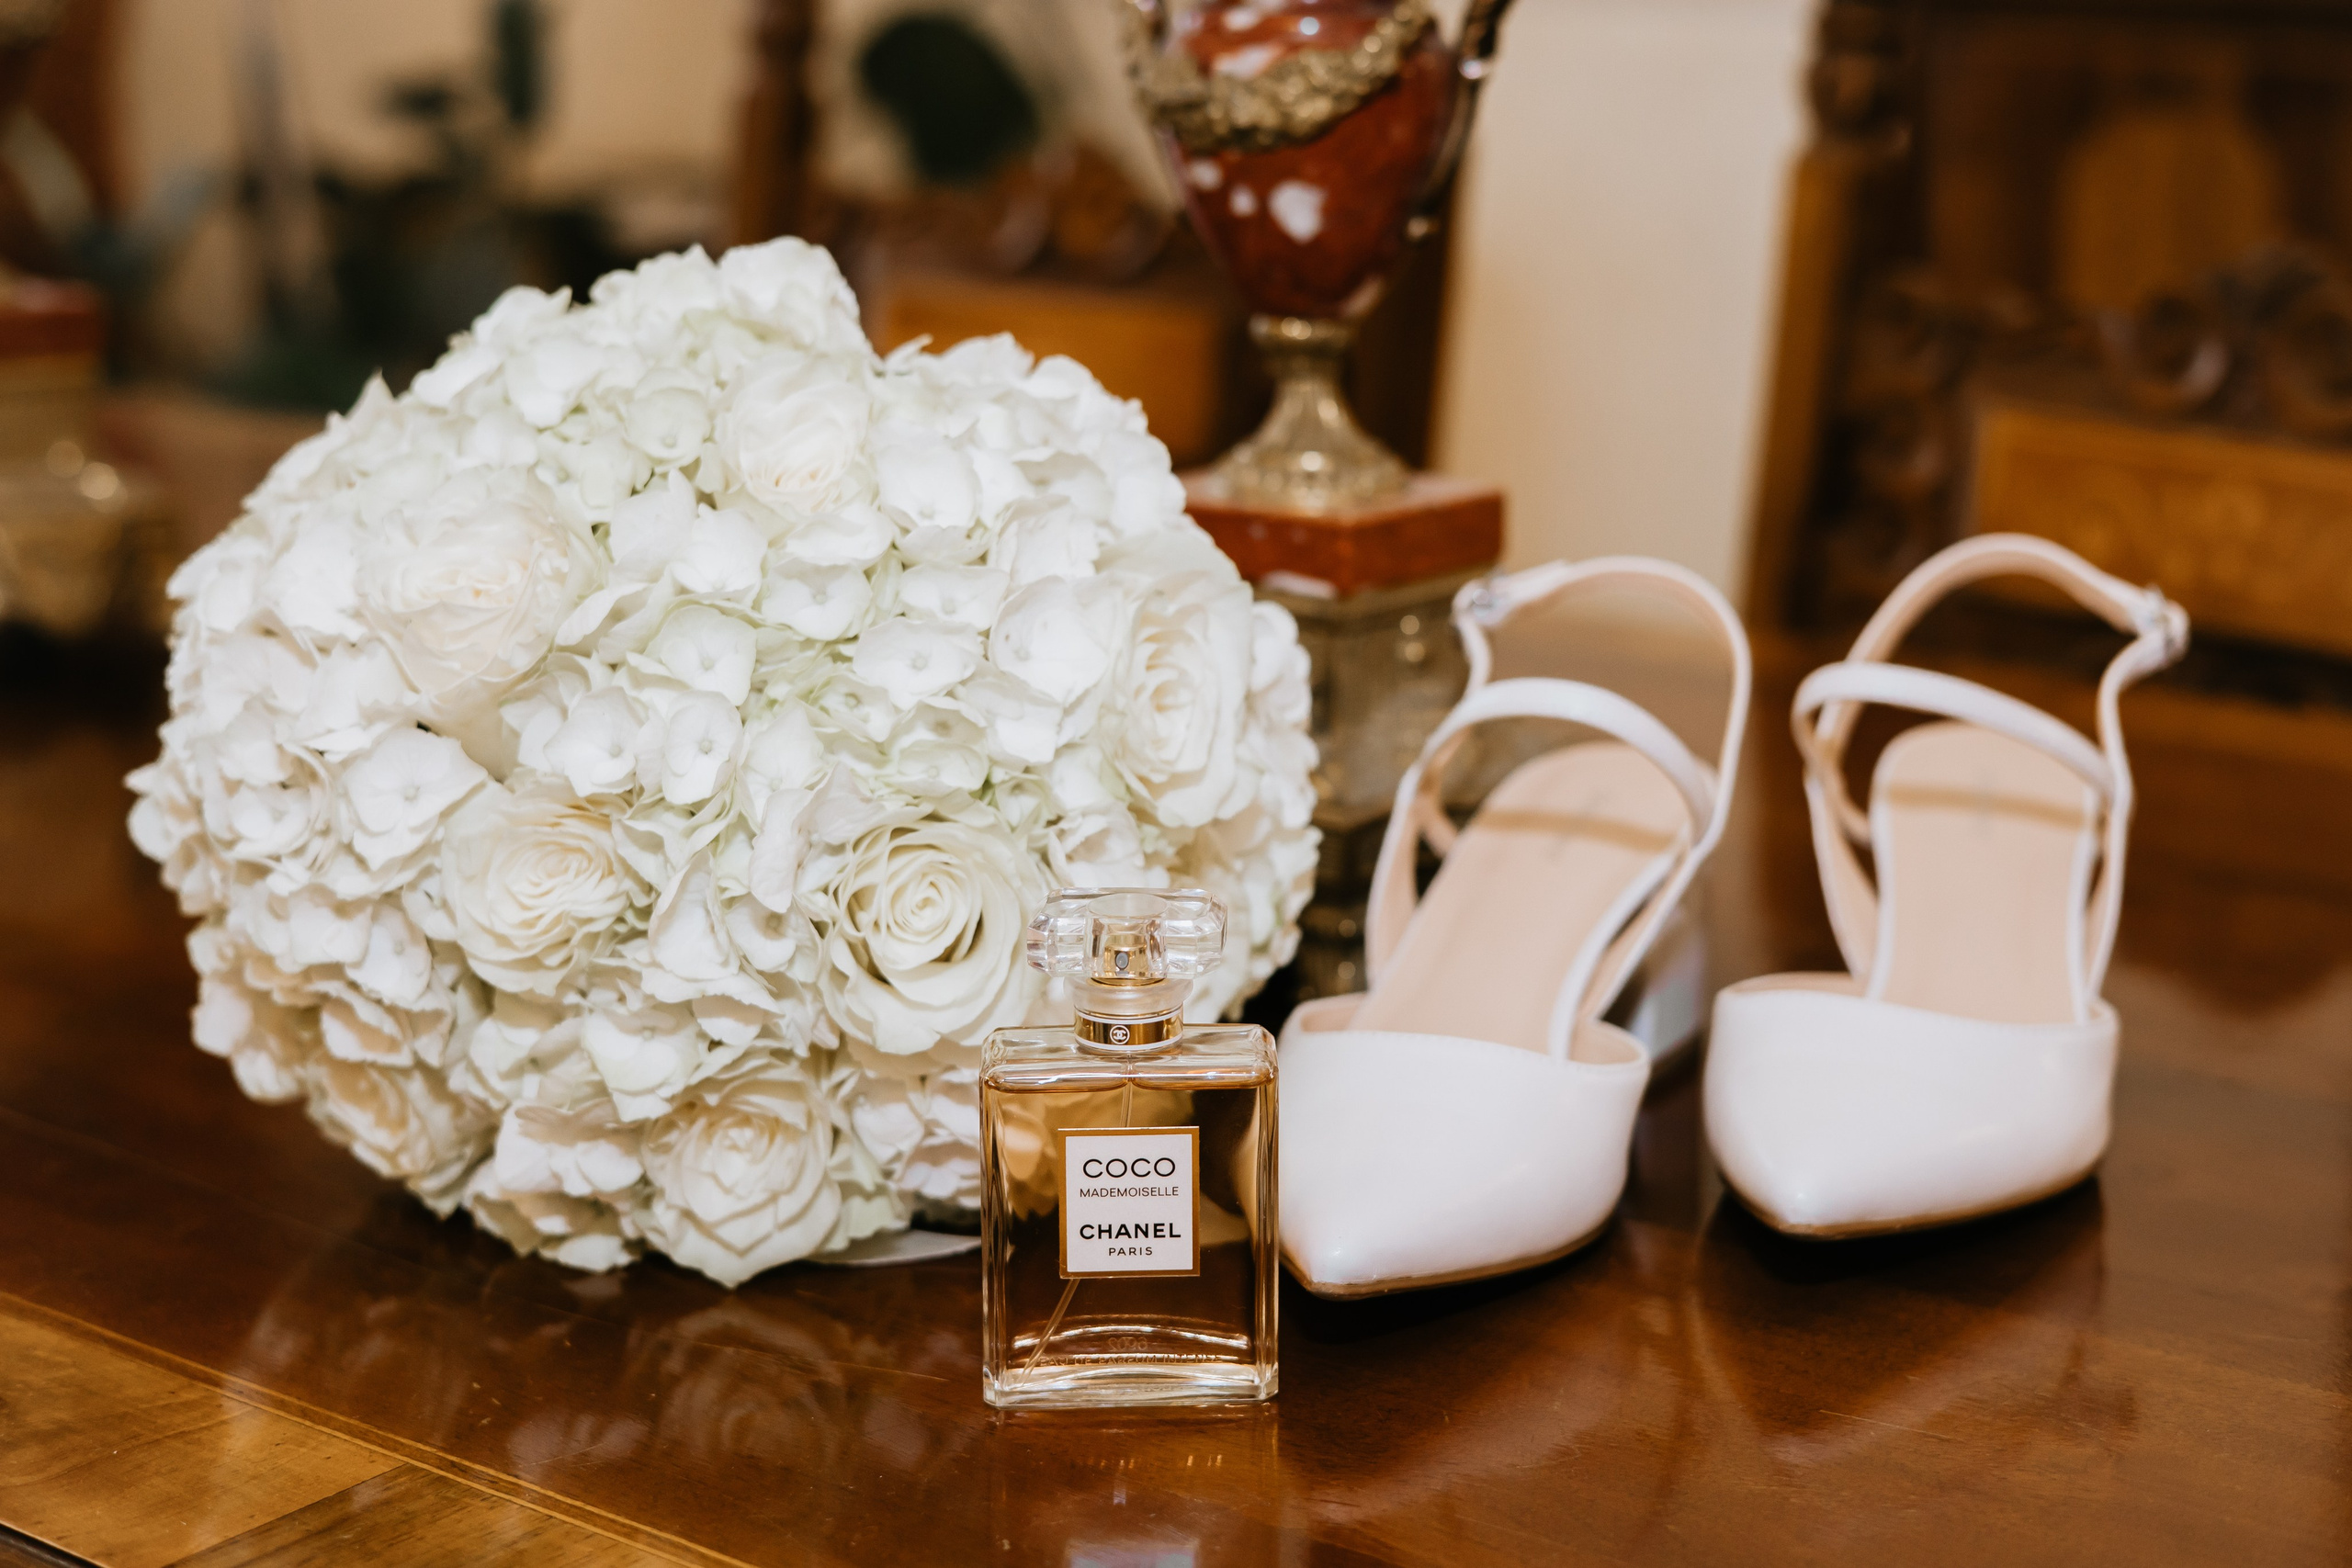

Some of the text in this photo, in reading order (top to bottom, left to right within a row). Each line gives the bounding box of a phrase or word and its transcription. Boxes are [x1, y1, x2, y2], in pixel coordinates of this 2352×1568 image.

[1082, 1157, 1176, 1179] COCO
[1080, 1186, 1180, 1198] MADEMOISELLE
[1080, 1222, 1182, 1240] CHANEL
[1108, 1247, 1153, 1257] PARIS
[1098, 1355, 1158, 1365] PARFUM
